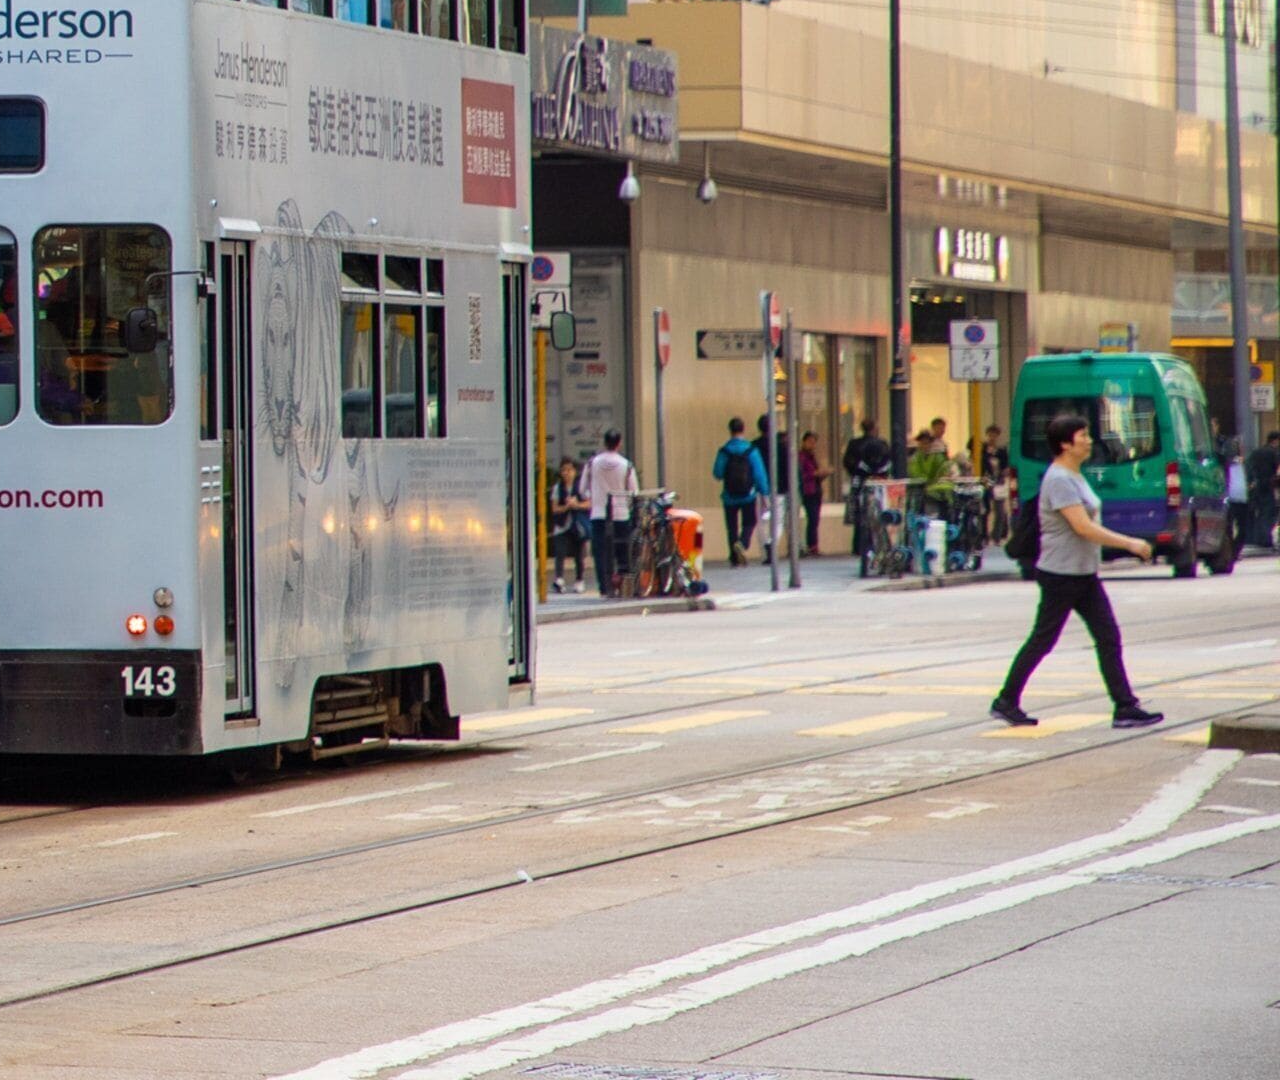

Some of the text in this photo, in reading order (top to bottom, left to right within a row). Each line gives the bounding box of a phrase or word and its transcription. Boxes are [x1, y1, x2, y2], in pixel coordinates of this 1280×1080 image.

[214, 38, 288, 89] Janus Henderson
[121, 664, 176, 697] 143
